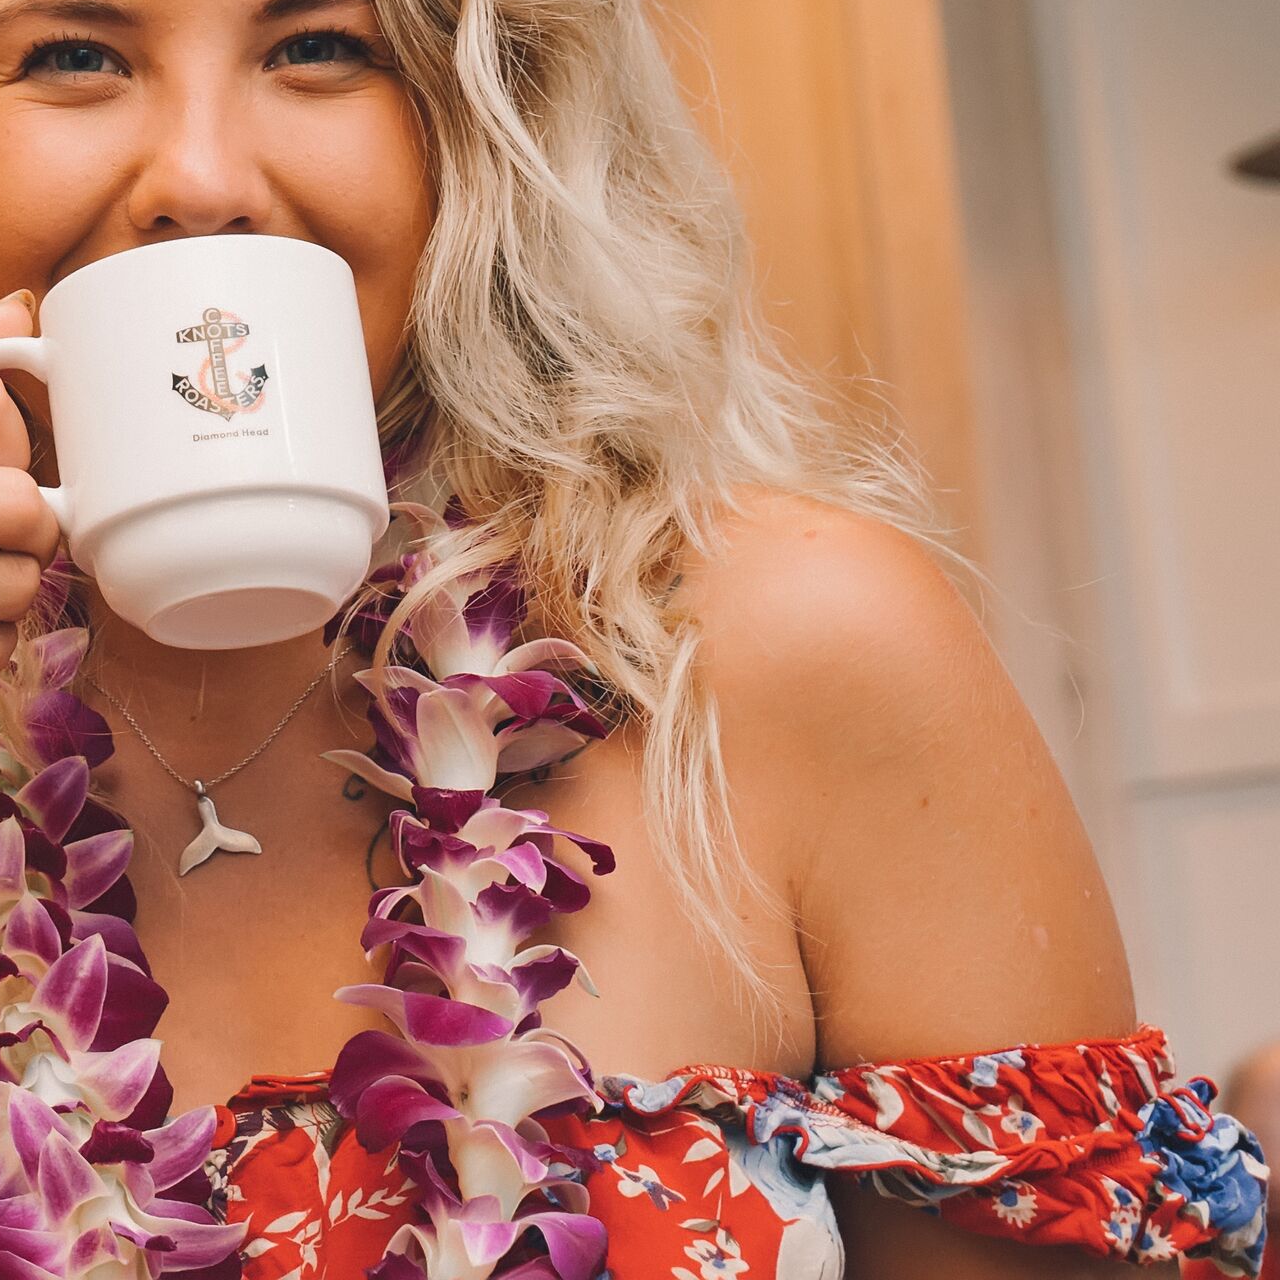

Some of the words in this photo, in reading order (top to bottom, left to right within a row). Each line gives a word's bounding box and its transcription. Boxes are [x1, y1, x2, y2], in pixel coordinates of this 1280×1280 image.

[178, 323, 249, 344] KNOTS
[205, 308, 228, 396] COFFEE
[192, 430, 240, 442] Diamond
[241, 428, 269, 437] Head
